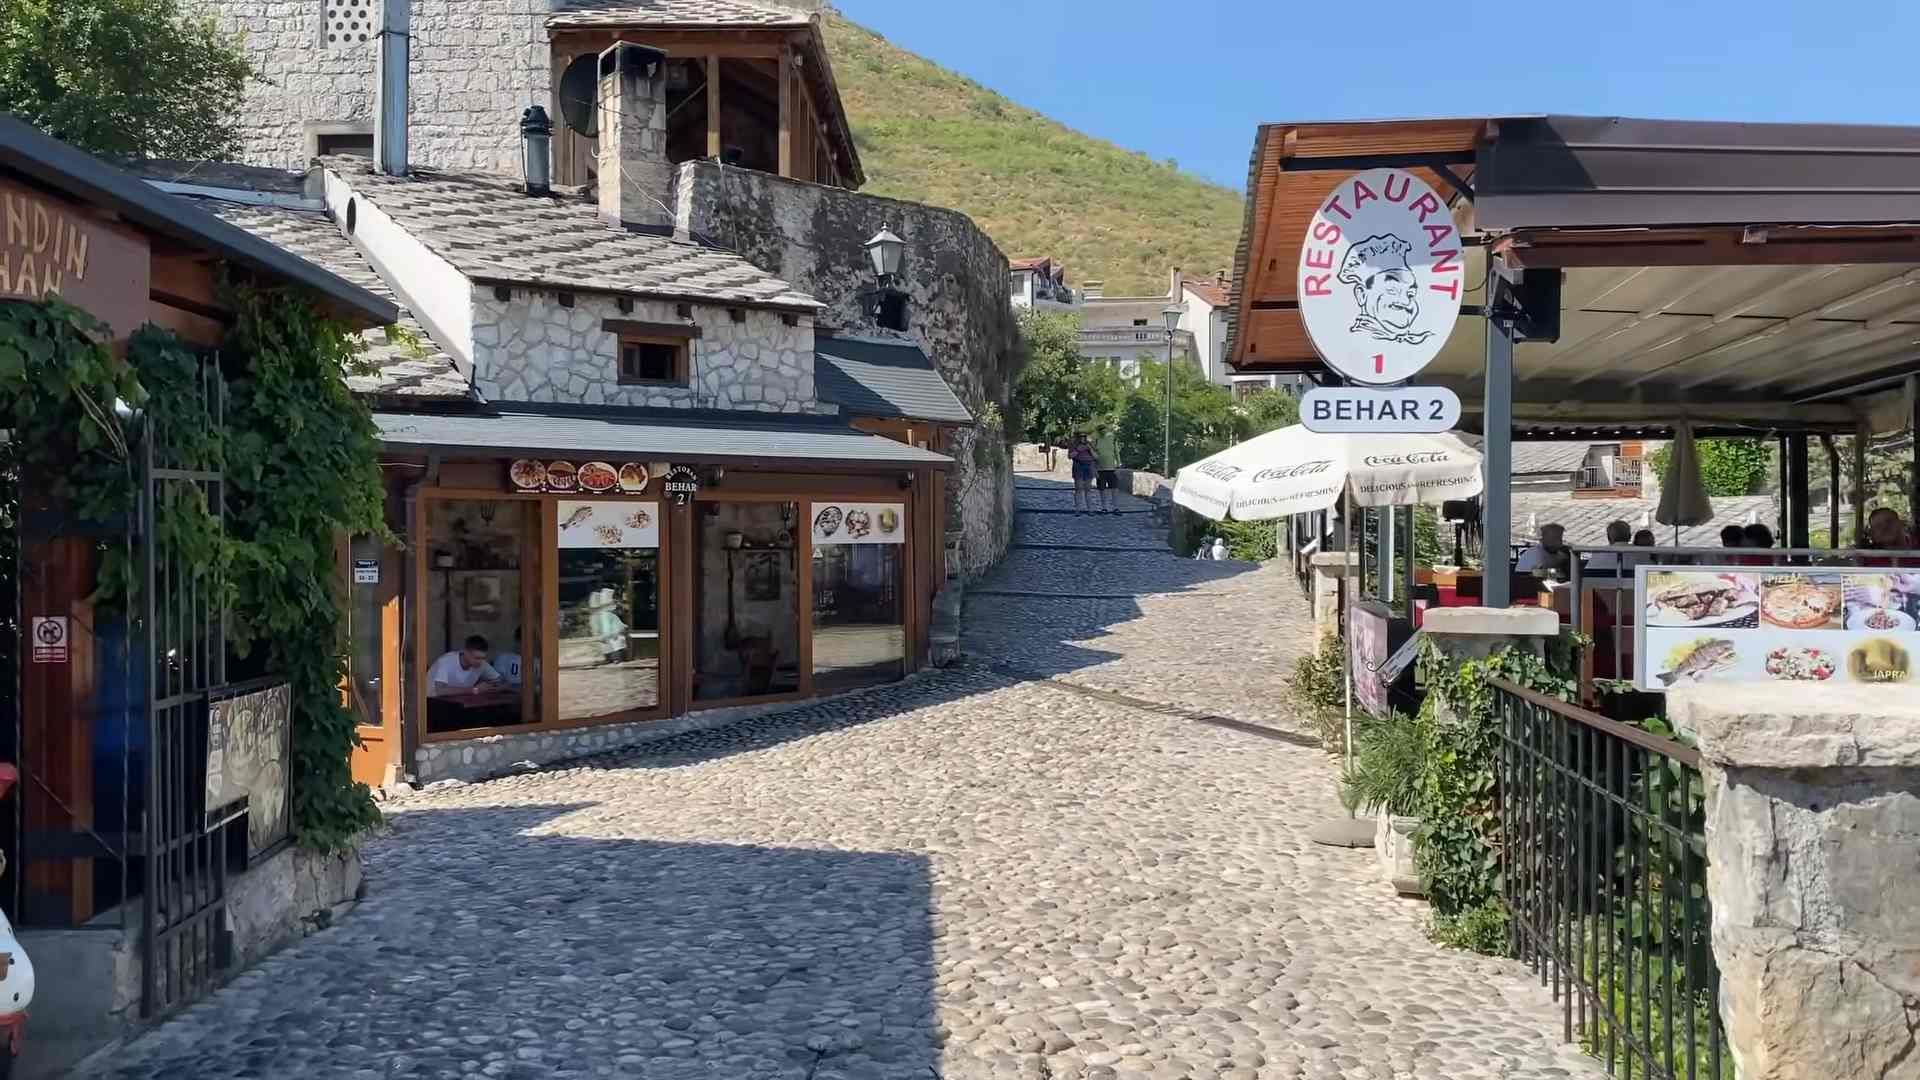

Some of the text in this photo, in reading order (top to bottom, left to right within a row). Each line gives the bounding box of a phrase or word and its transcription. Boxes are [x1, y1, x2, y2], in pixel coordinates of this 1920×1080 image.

[5, 192, 88, 279] NDIN
[1304, 173, 1460, 300] RESTAURANT
[1371, 353, 1385, 374] 1
[1313, 399, 1445, 420] BEHAR 2
[665, 482, 697, 491] BEHAR
[1360, 481, 1409, 494] DELICIOUS
[677, 493, 685, 505] 2
